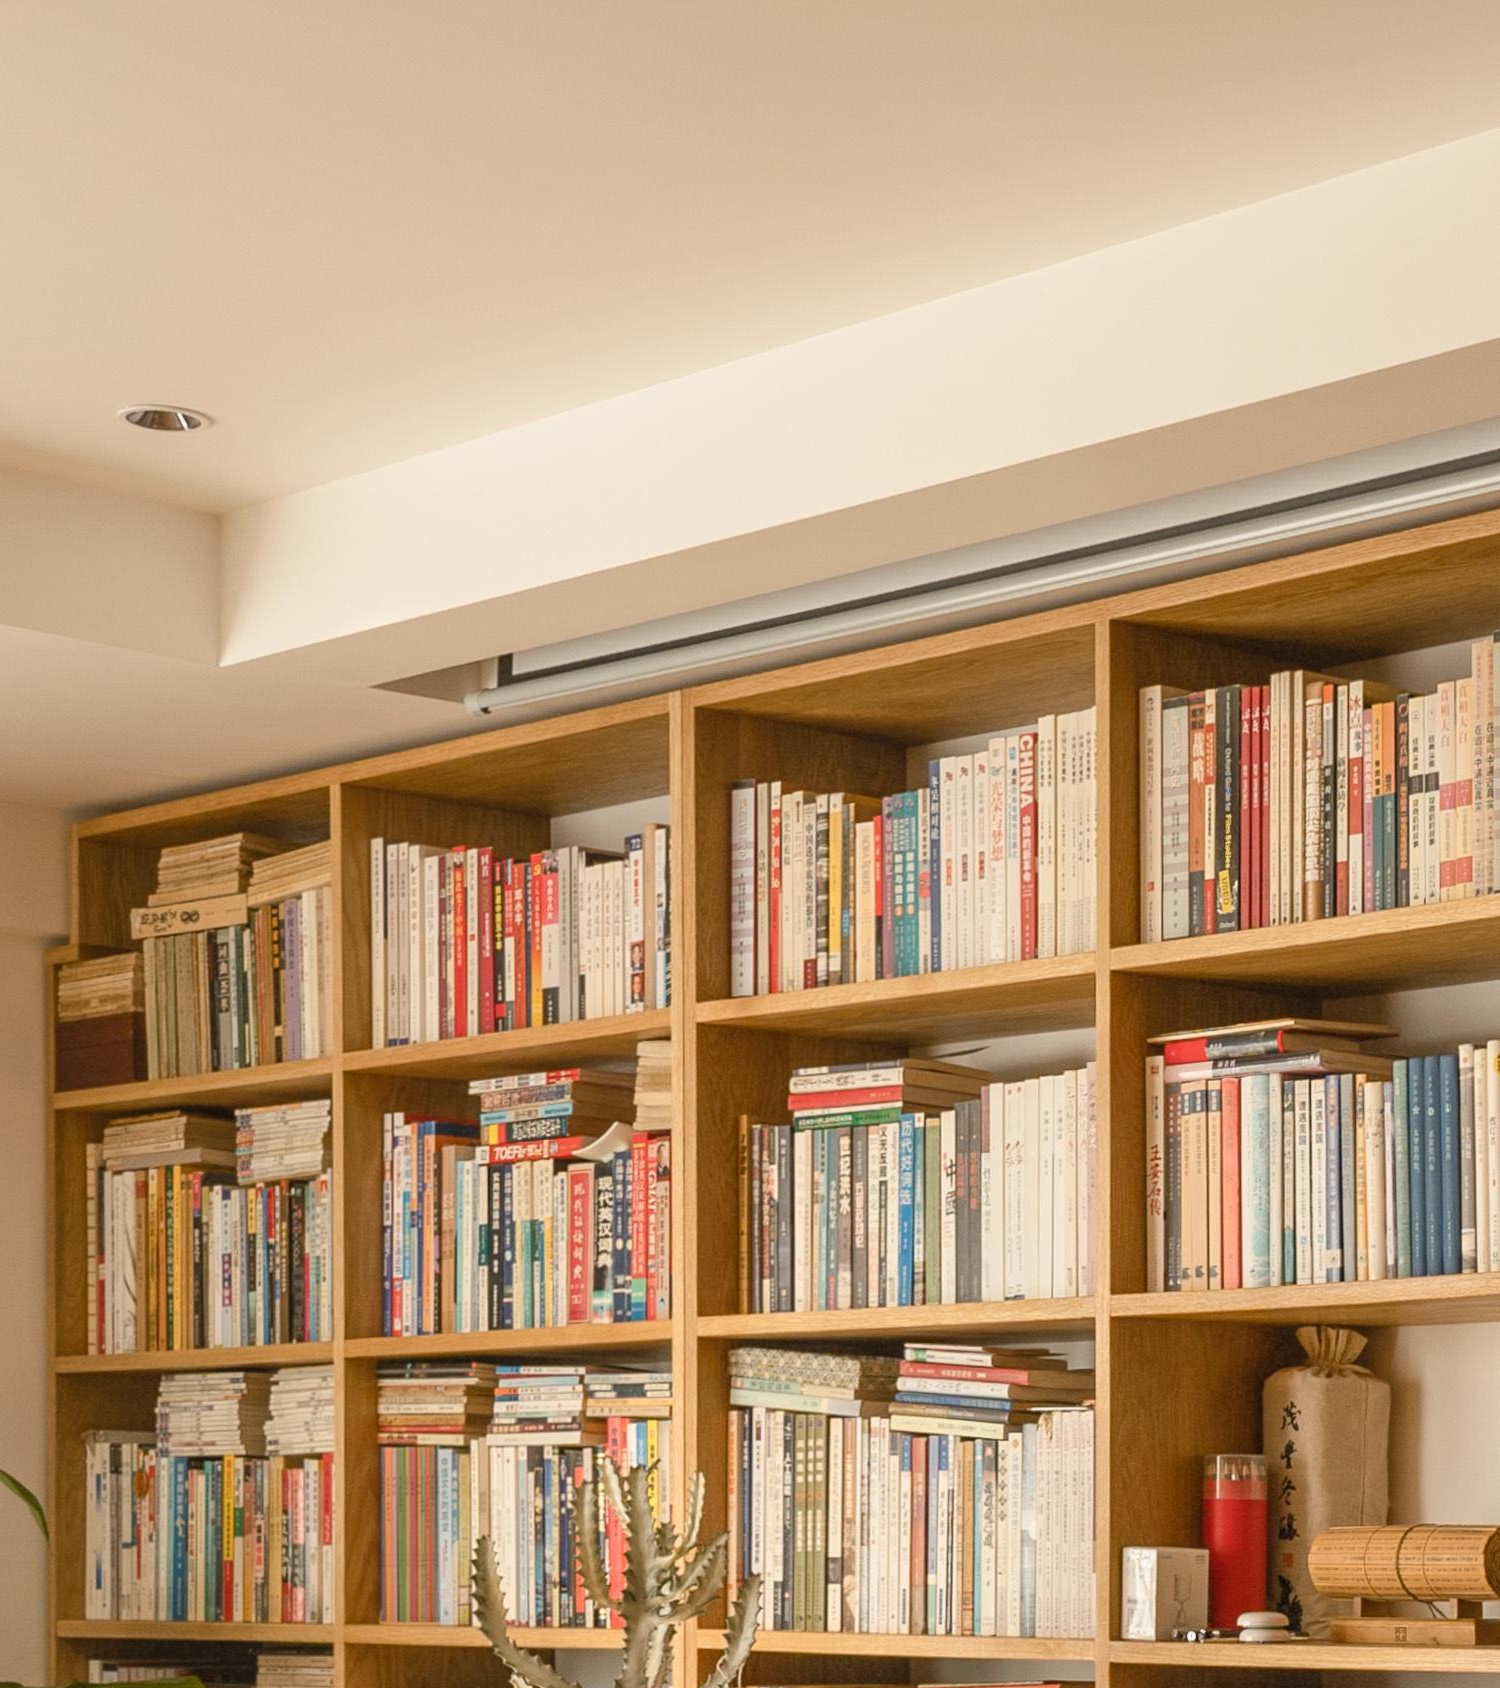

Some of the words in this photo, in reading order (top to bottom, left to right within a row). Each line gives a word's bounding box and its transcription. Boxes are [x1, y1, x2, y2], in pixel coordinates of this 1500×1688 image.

[1018, 733, 1034, 809] CHINA
[1148, 1145, 1162, 1217] 王安石传
